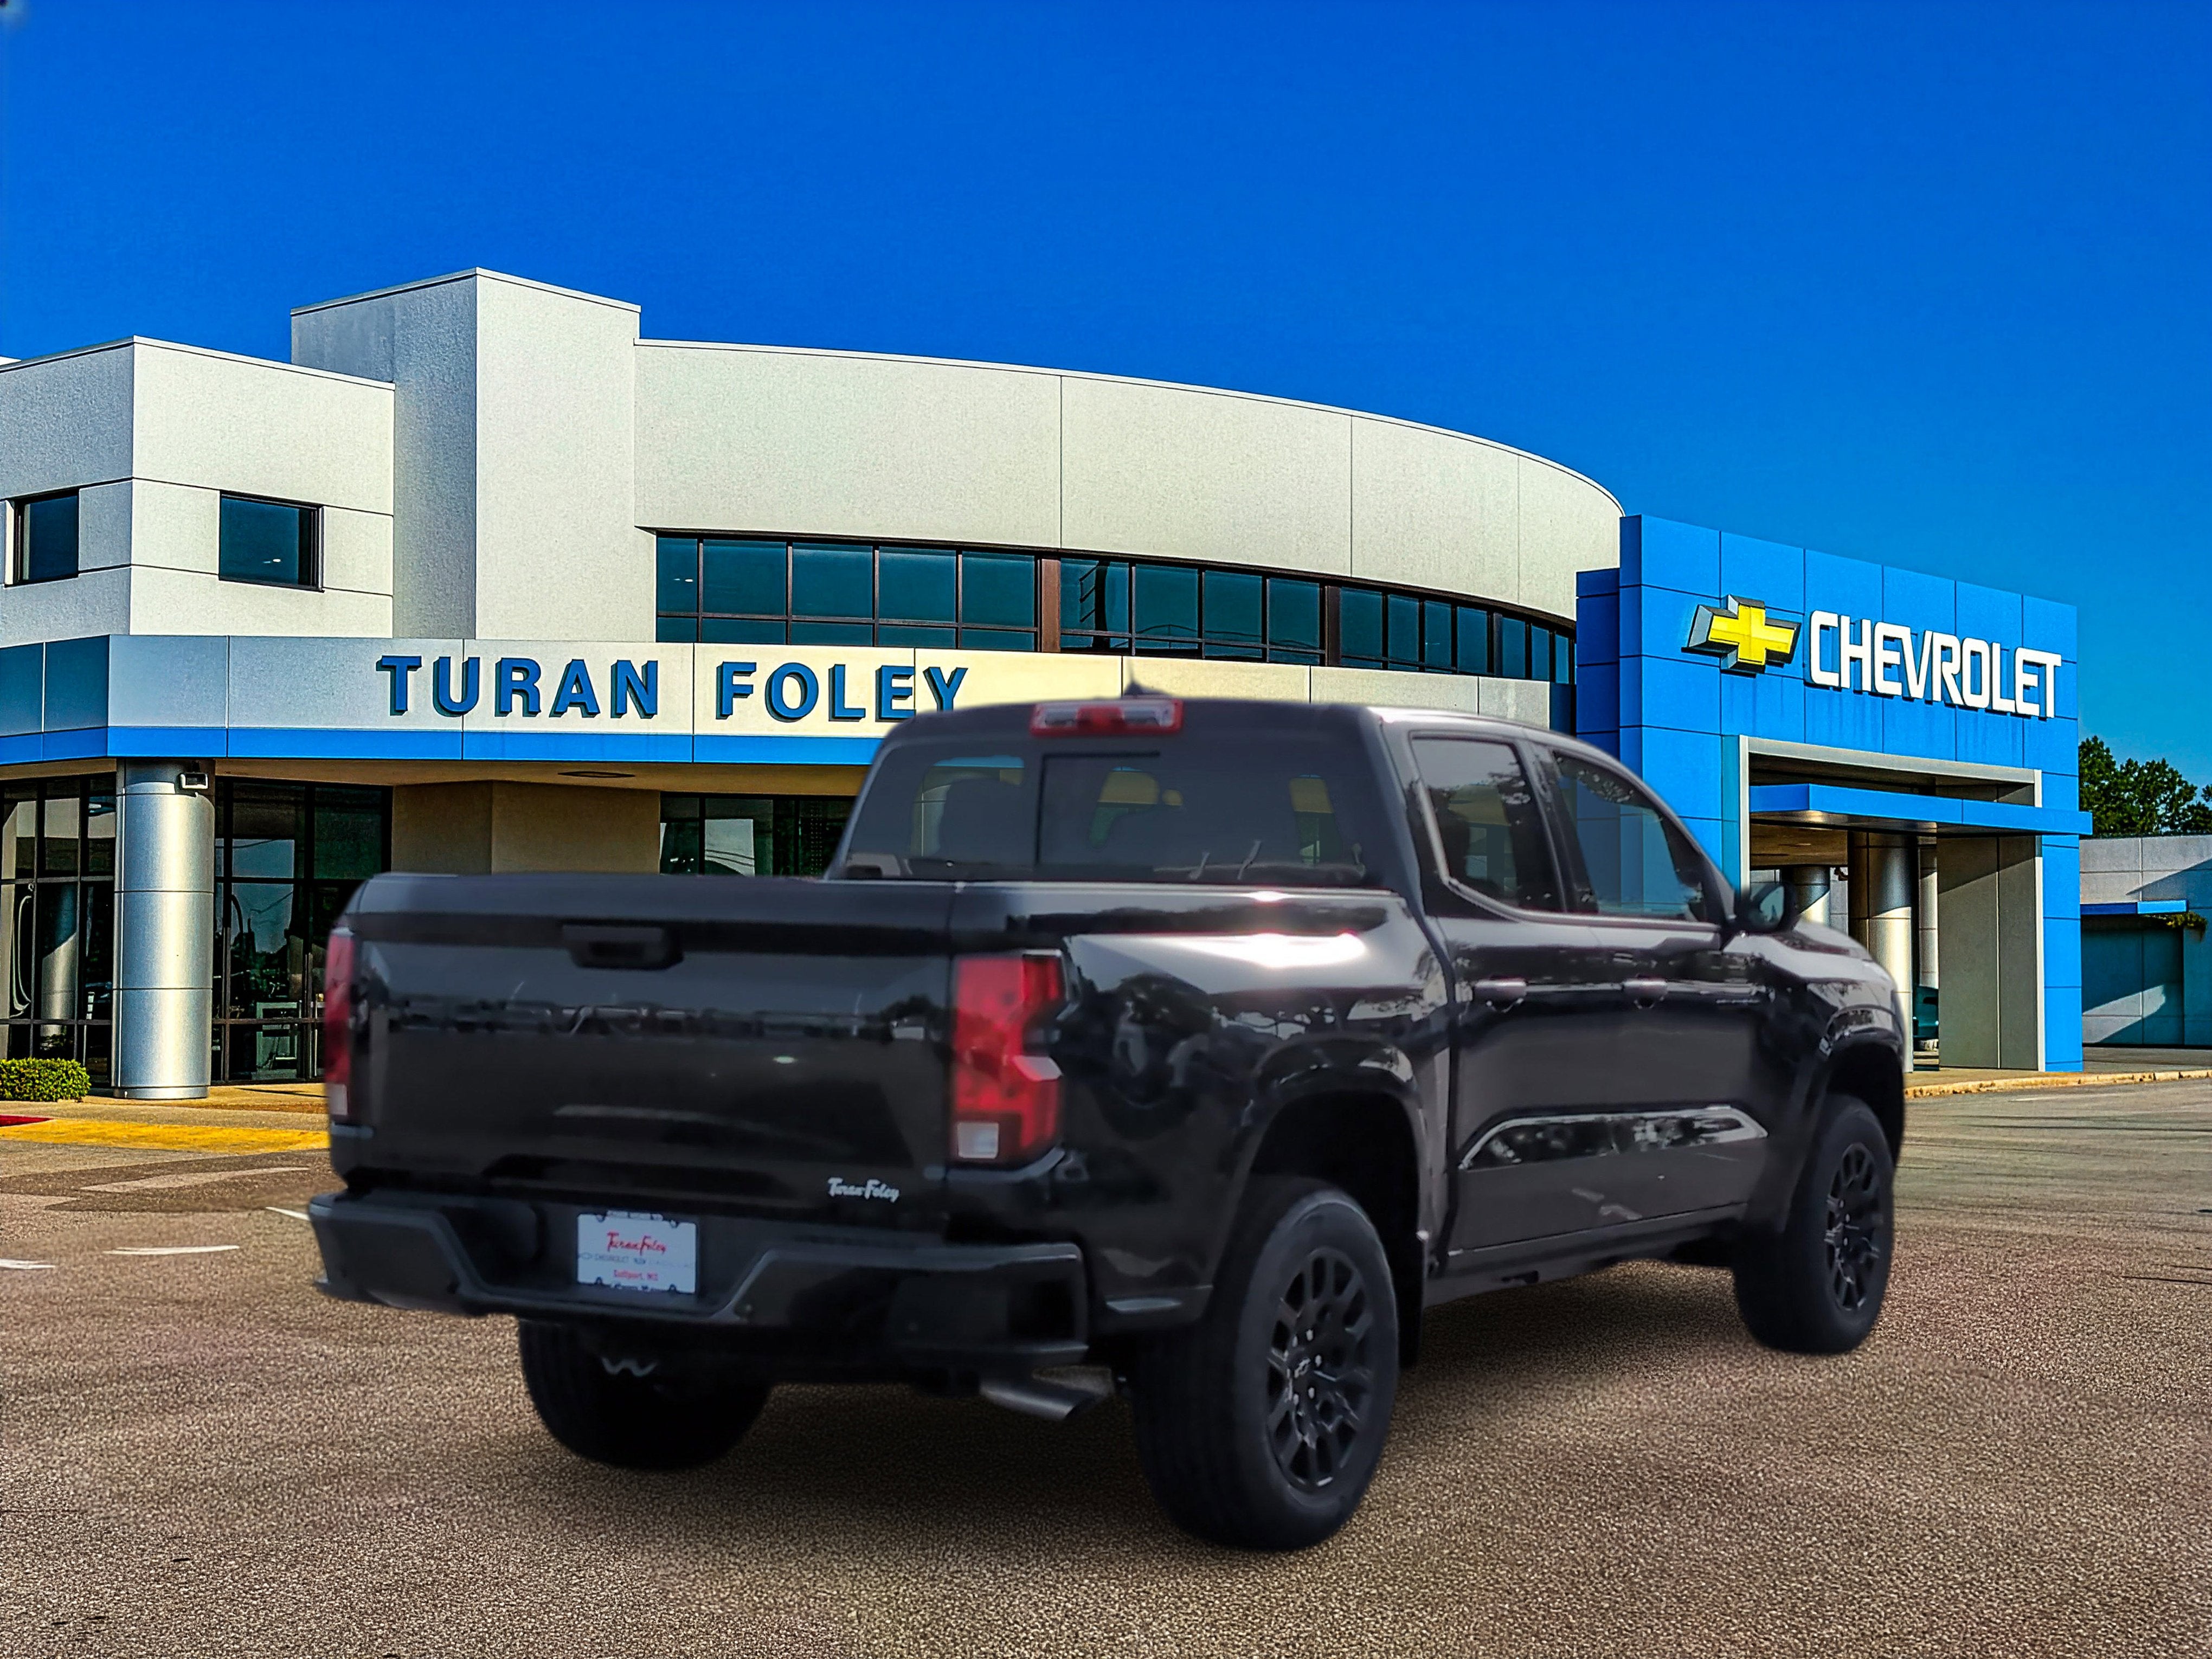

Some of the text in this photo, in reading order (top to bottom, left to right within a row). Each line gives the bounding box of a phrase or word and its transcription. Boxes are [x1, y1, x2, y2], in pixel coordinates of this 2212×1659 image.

[376, 655, 969, 723] TURAN FOLEY
[1810, 610, 2062, 718] CHEVROLET
